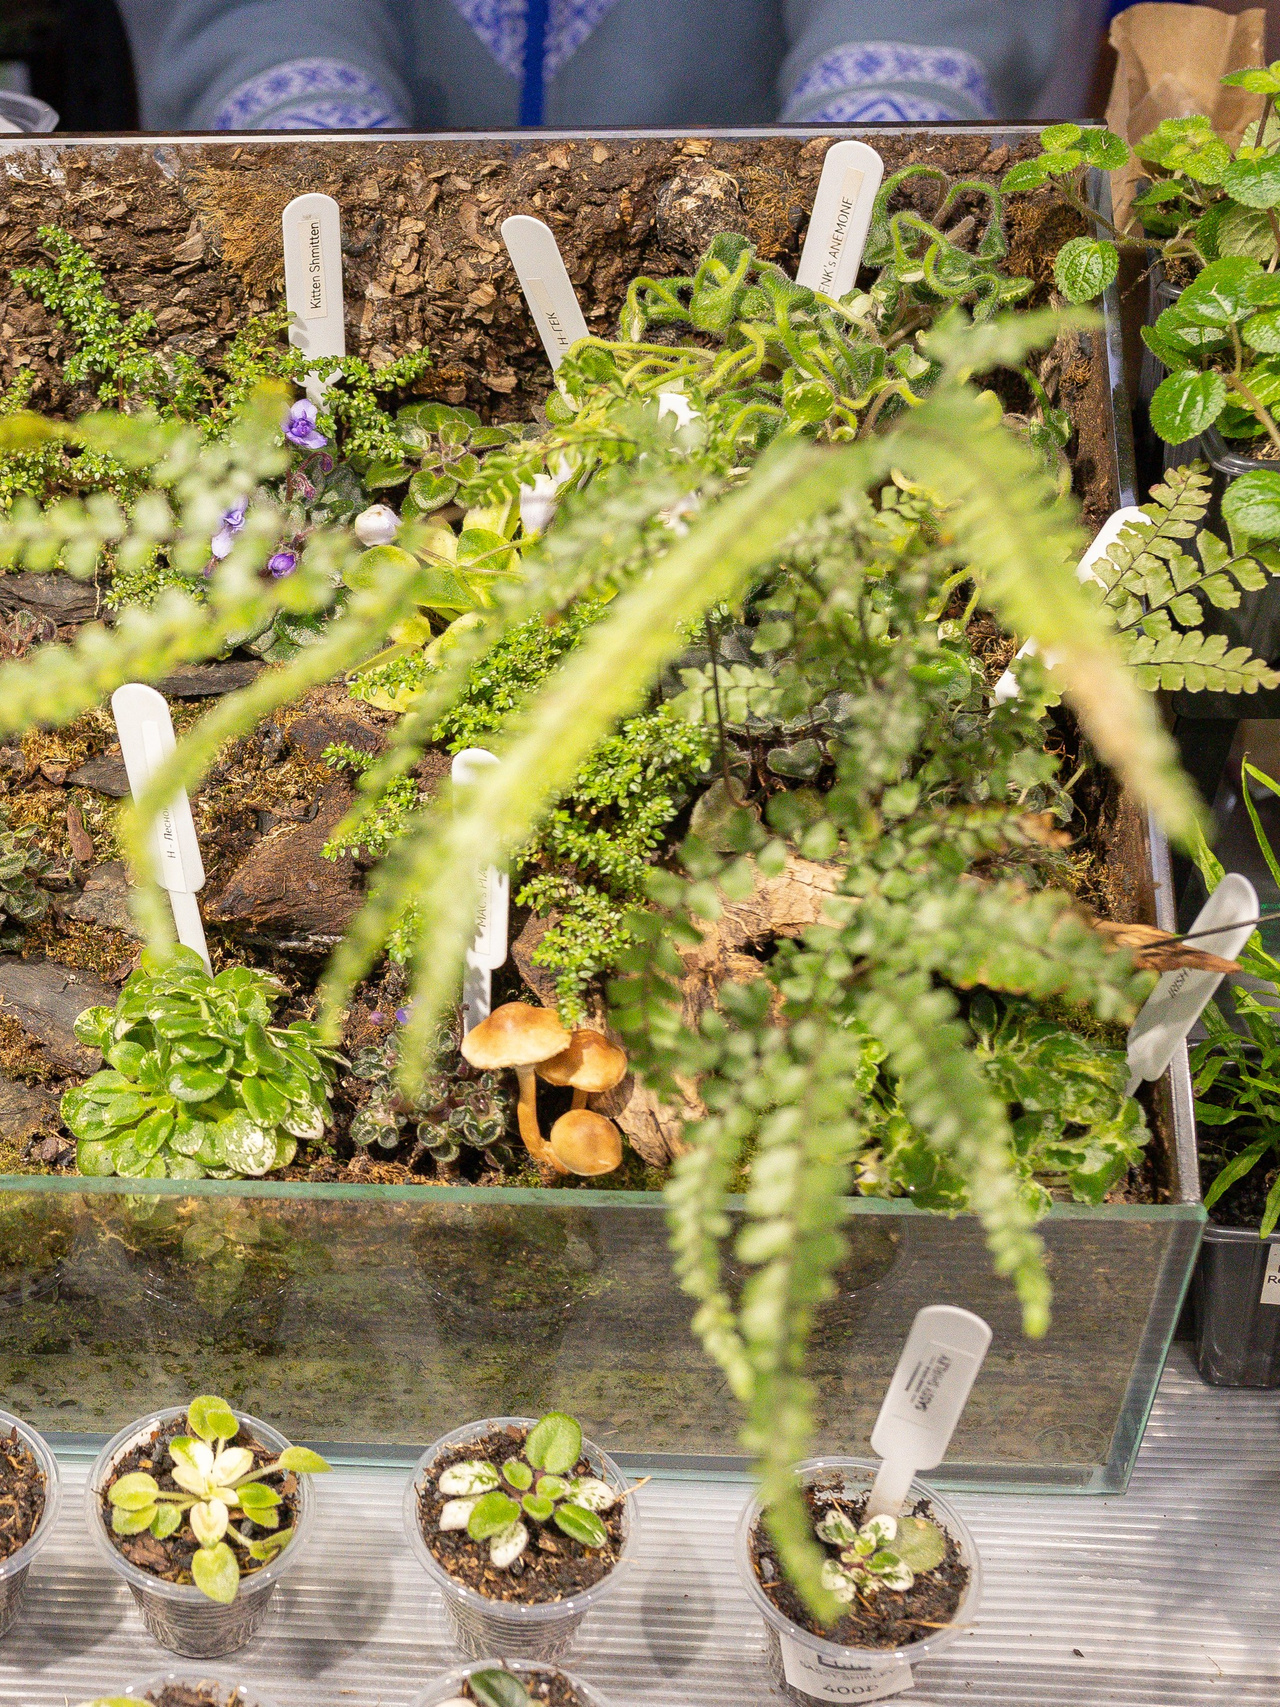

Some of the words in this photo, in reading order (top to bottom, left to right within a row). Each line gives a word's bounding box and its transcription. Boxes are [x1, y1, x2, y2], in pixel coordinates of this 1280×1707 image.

[309, 221, 321, 274] Shmitten
[828, 196, 854, 260] ANEMONE
[310, 275, 322, 310] Kitten
